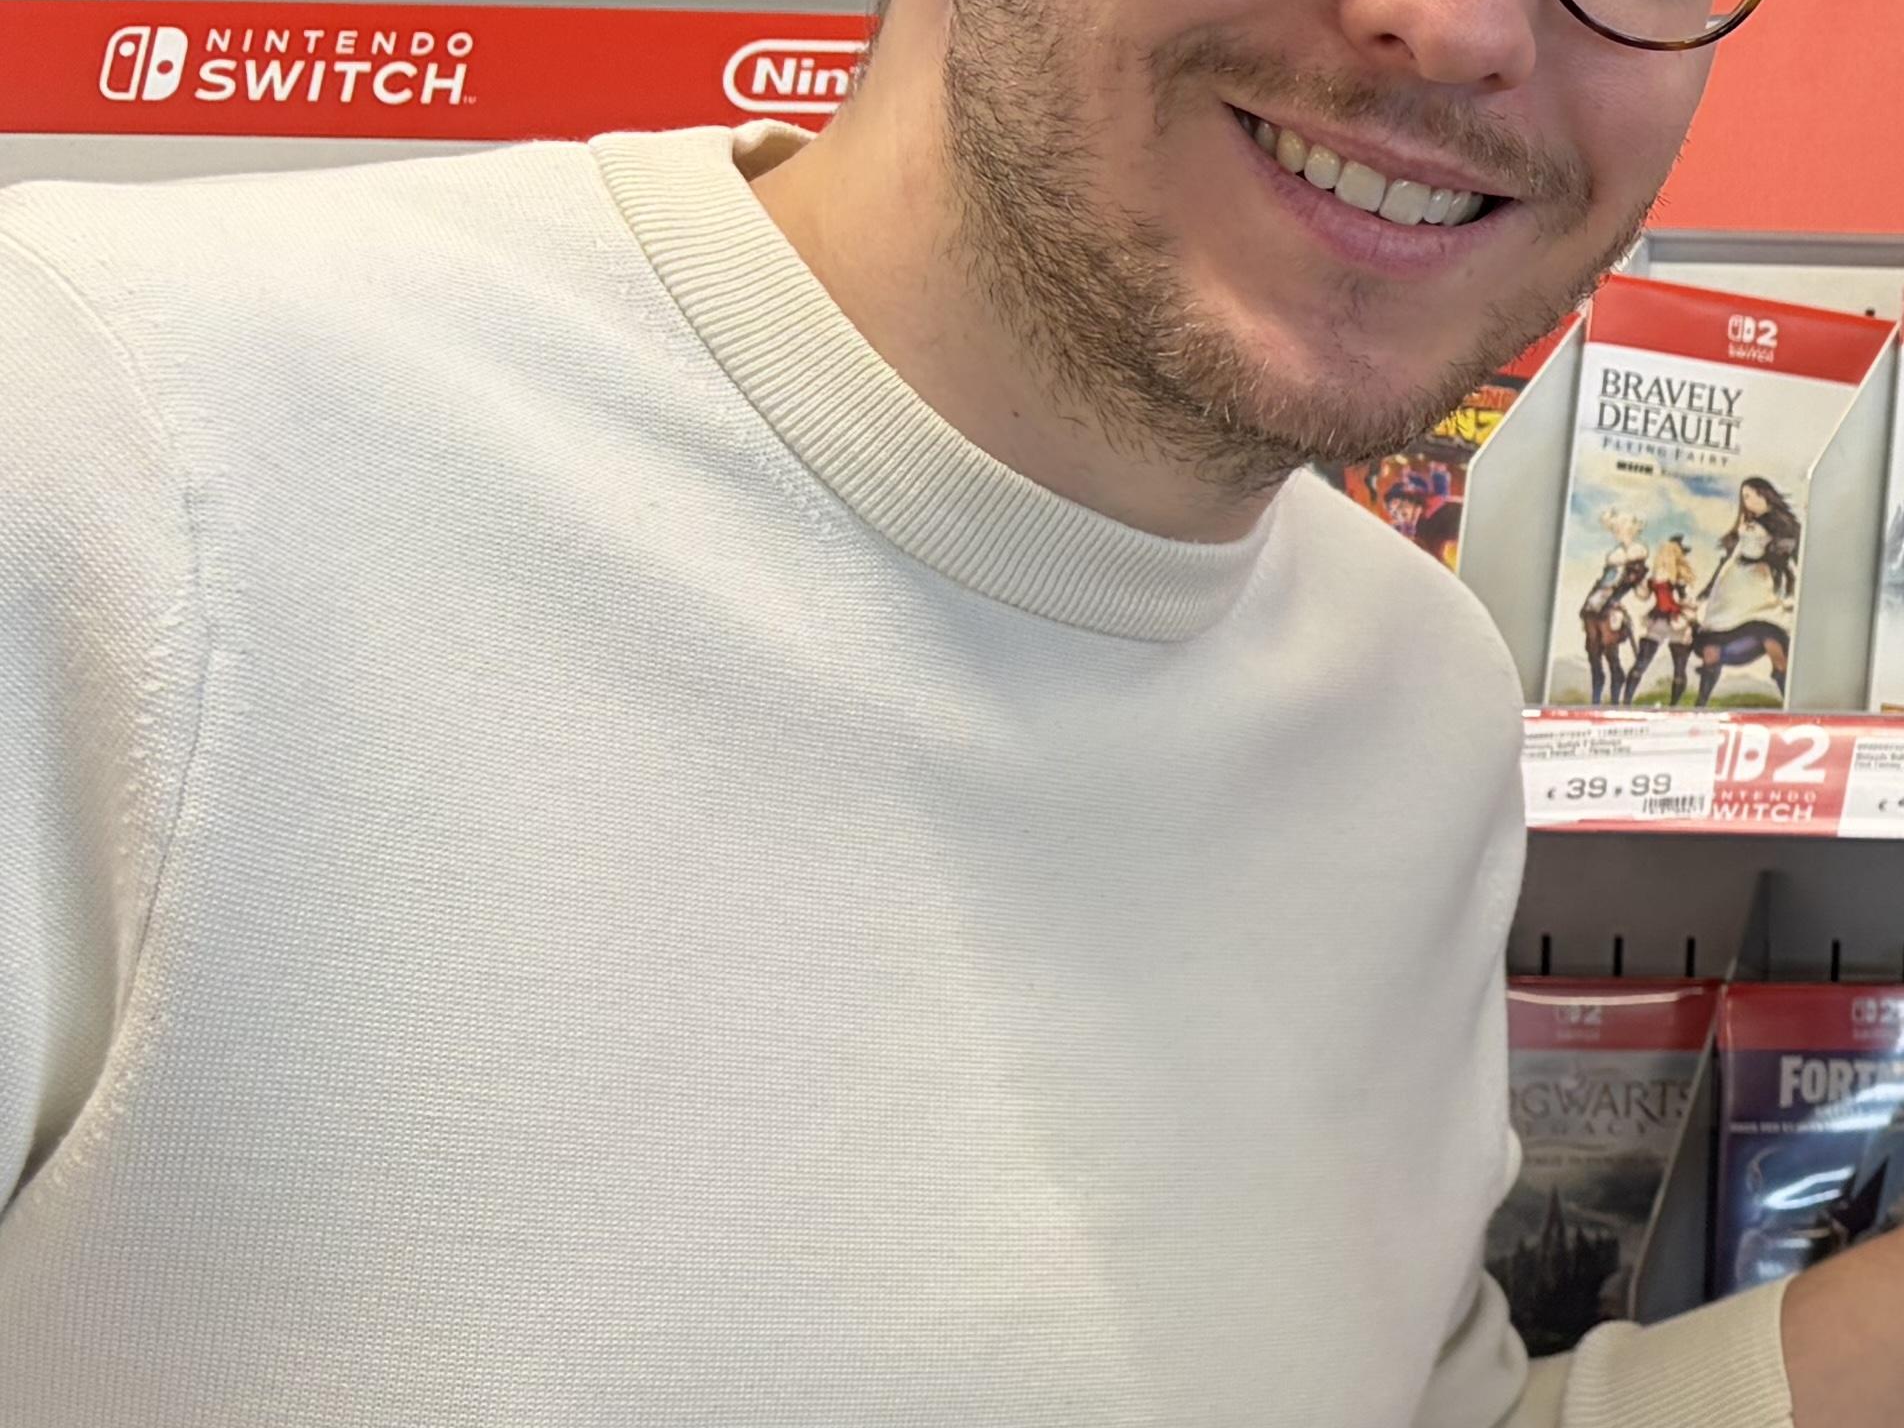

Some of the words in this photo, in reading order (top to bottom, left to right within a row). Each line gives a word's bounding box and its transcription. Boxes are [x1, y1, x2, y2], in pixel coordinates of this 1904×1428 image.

[205, 28, 474, 58] NINTENDO
[194, 58, 468, 106] SWITCH
[750, 56, 853, 95] Nin
[1600, 367, 1743, 418] BRAVELY
[1596, 401, 1742, 451] DEFAULT
[1566, 773, 1673, 801] 39,99
[1712, 804, 1816, 824] WITCH
[1519, 1079, 1691, 1120] GWARTS
